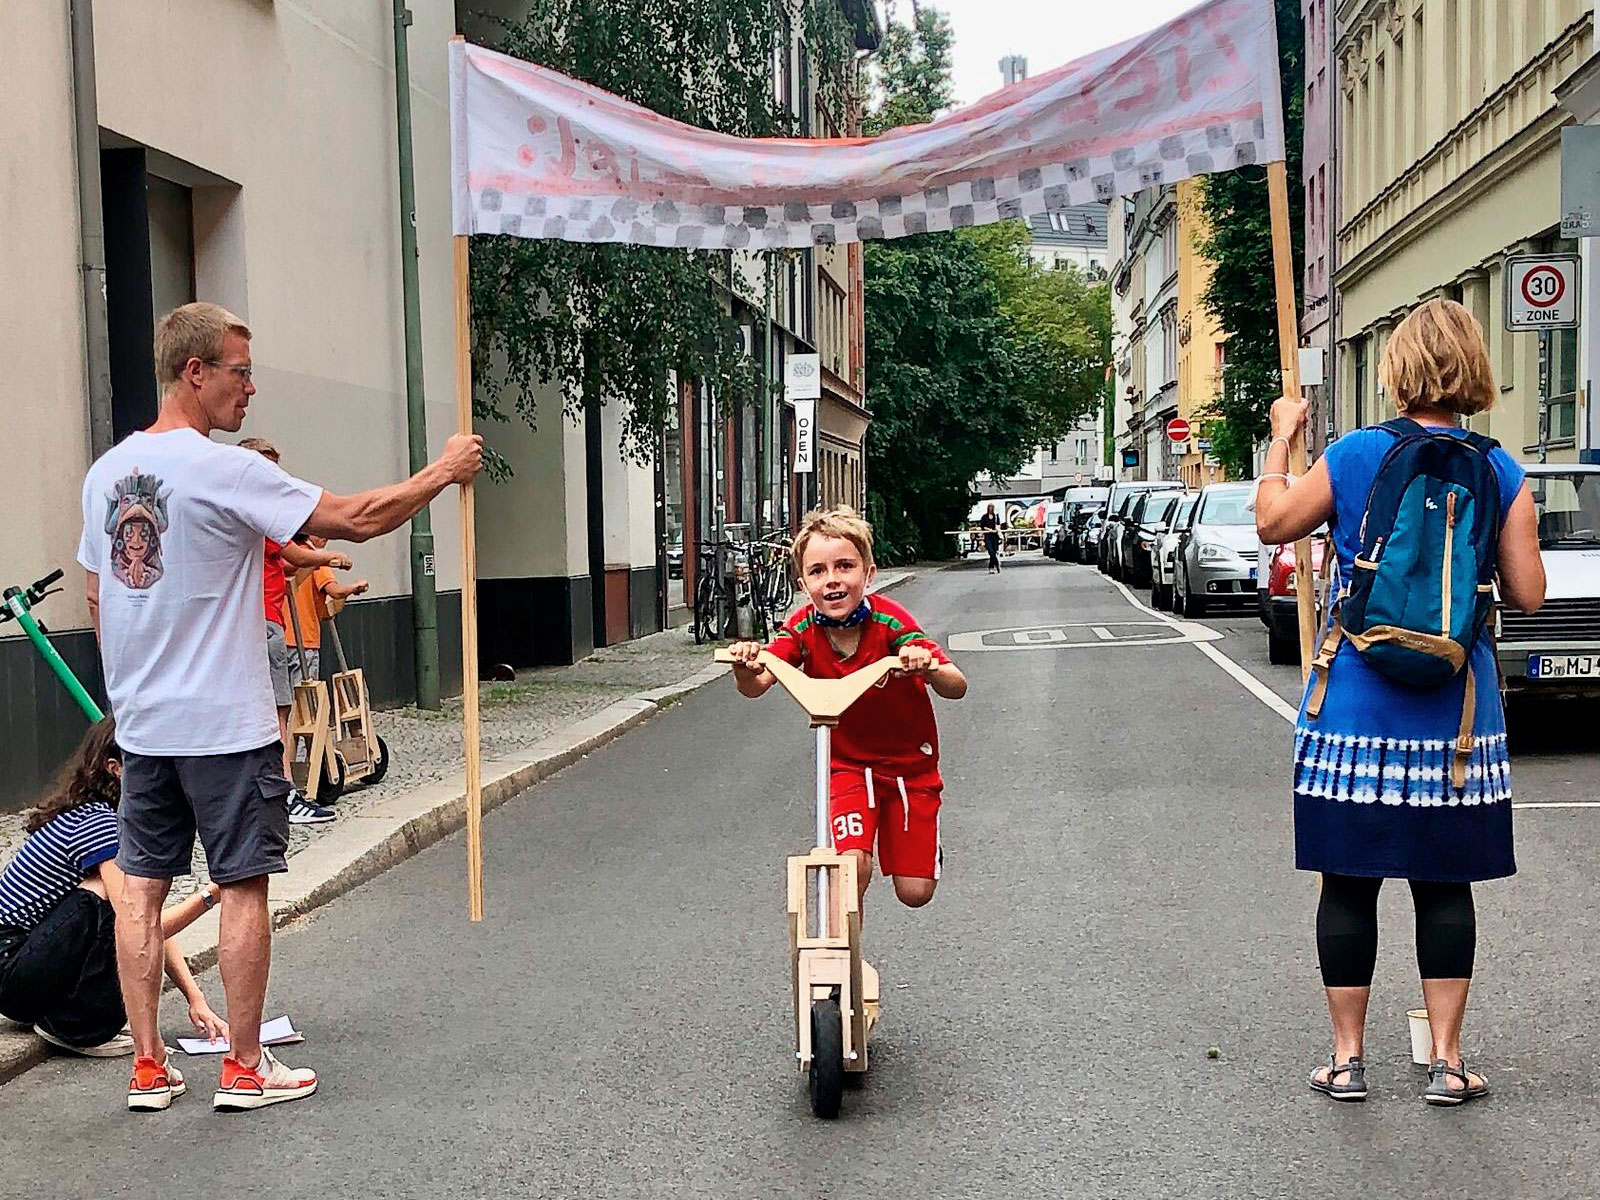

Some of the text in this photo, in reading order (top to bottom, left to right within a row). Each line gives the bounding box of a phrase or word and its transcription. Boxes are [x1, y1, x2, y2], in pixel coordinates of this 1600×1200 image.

[1531, 277, 1556, 296] 30
[1526, 310, 1560, 321] ZONE
[798, 418, 809, 463] OPEN
[1541, 658, 1553, 675] B
[833, 812, 864, 840] 36
